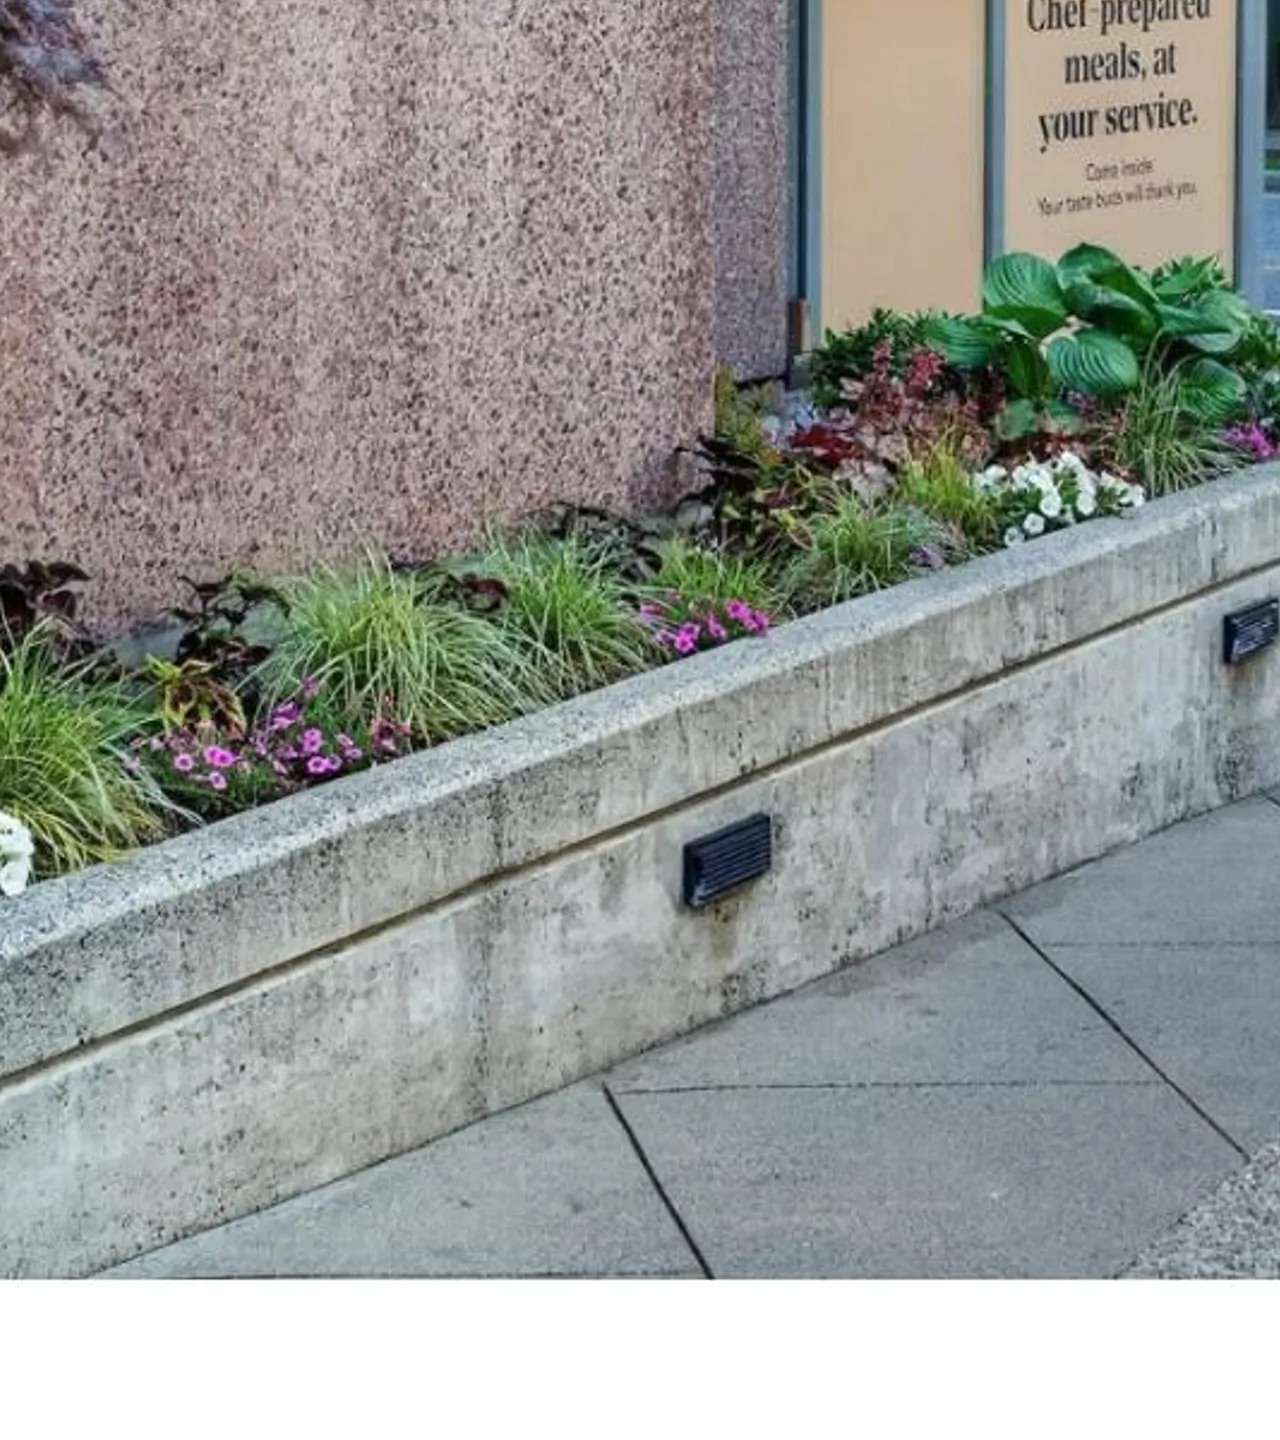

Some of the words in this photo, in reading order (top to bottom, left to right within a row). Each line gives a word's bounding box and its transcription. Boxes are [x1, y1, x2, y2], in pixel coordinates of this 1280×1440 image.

[1064, 41, 1147, 85] meals,
[1153, 41, 1177, 76] at
[1038, 109, 1098, 155] your
[1105, 91, 1198, 136] service.
